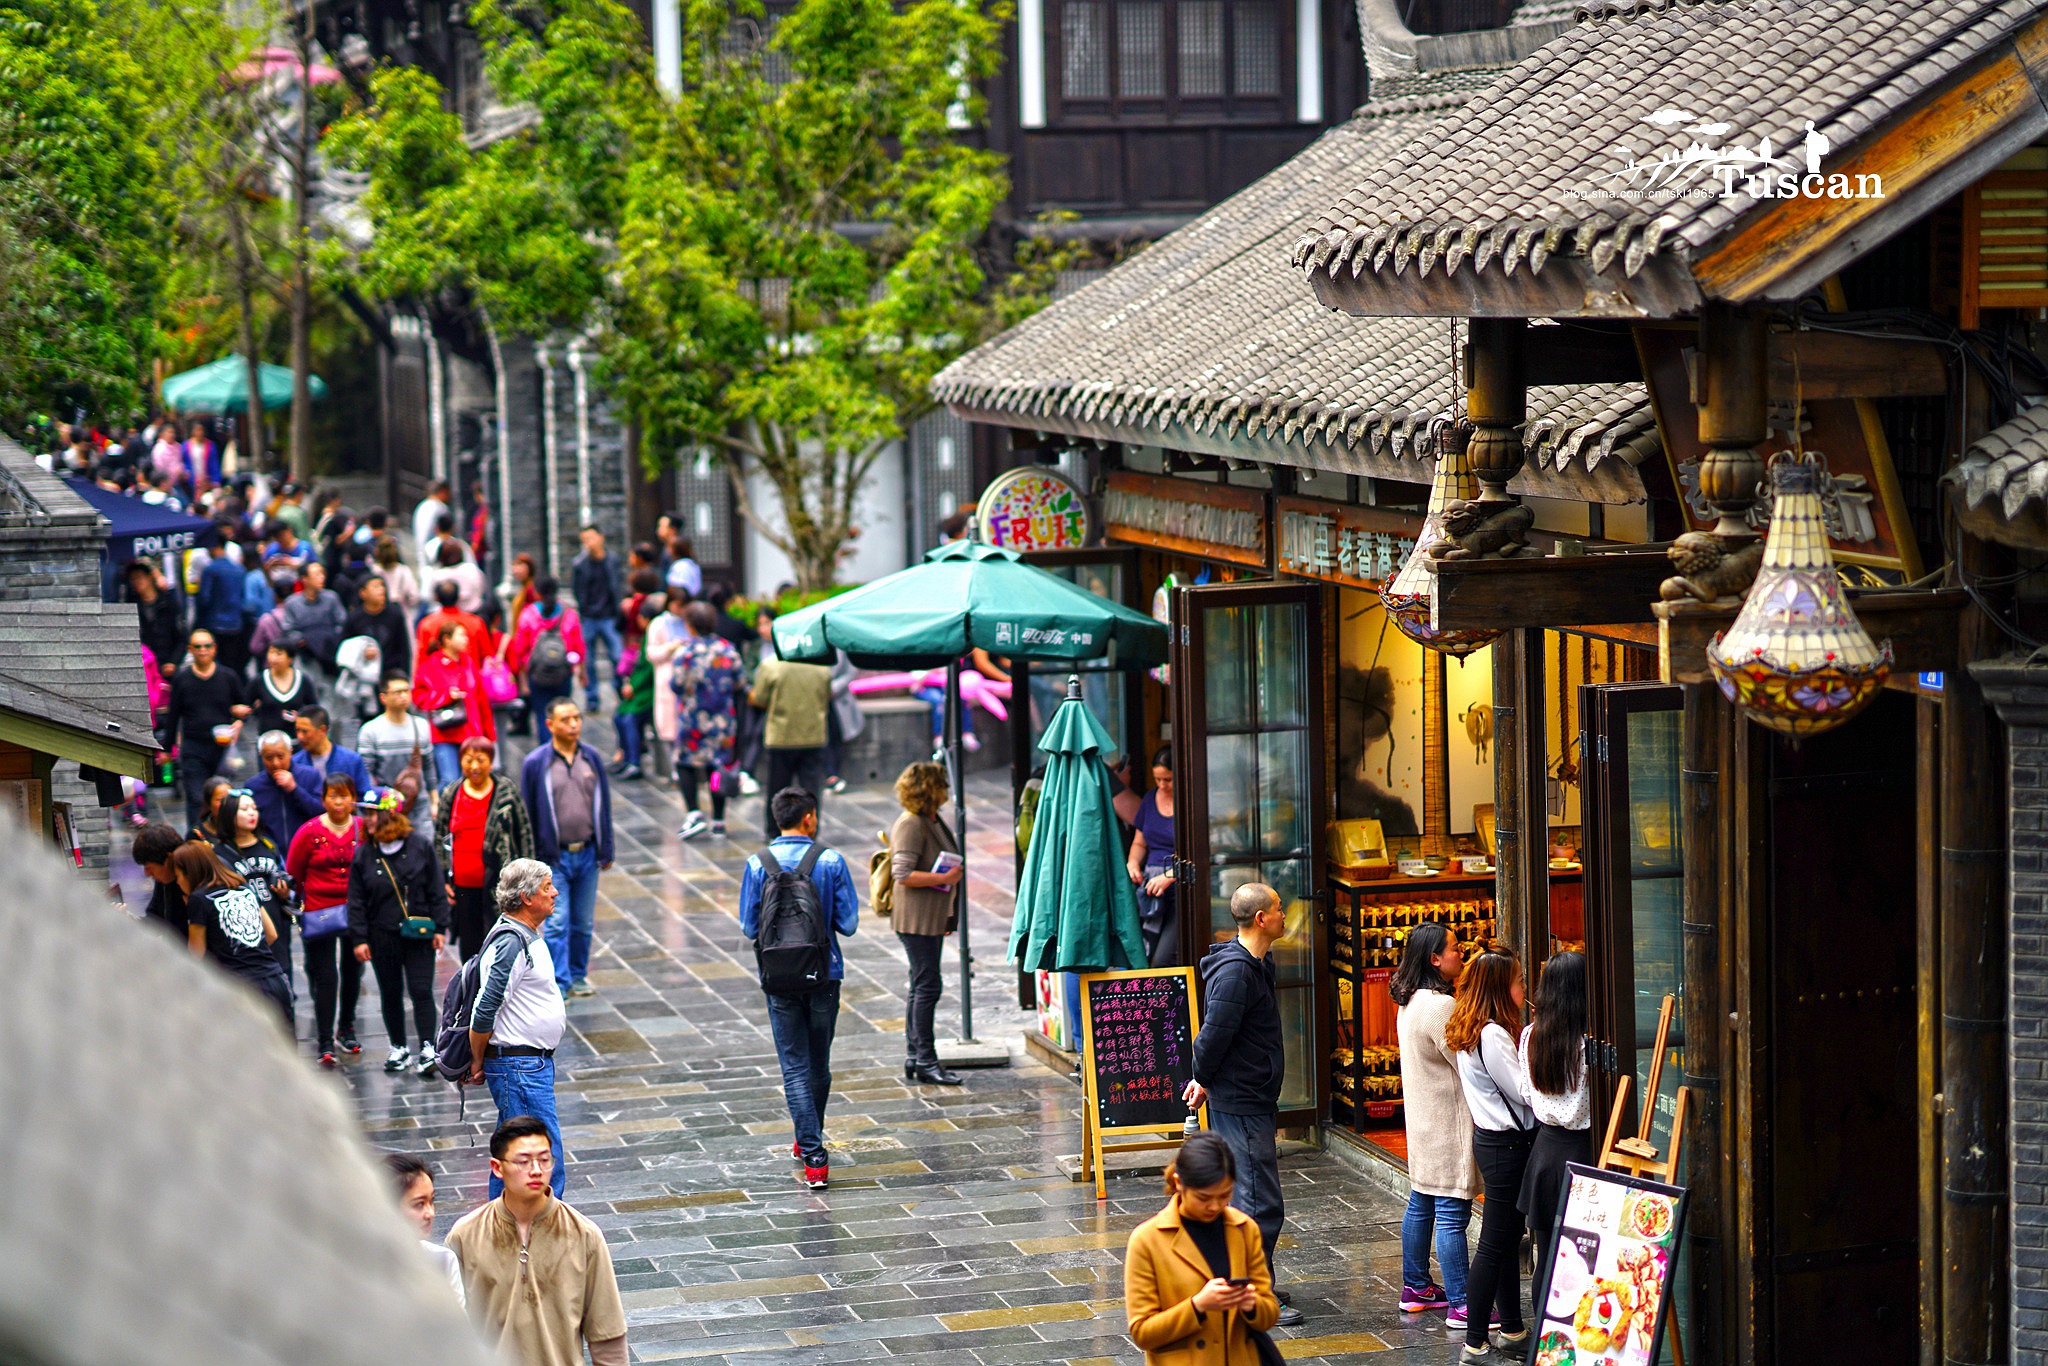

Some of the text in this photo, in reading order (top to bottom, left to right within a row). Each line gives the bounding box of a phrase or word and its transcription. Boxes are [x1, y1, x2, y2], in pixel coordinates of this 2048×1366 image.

[990, 510, 1083, 547] FRUIT
[133, 531, 195, 557] POLICE
[1021, 627, 1068, 645] 可口可乐
[1174, 995, 1185, 1007] 19
[1164, 1007, 1177, 1019] 26
[1163, 1018, 1175, 1030] 26
[1163, 1030, 1175, 1041] 26
[1165, 1042, 1177, 1055] 29
[1166, 1055, 1180, 1067] 29
[1570, 1178, 1600, 1205] 特色
[1582, 1210, 1609, 1229] 小吃
